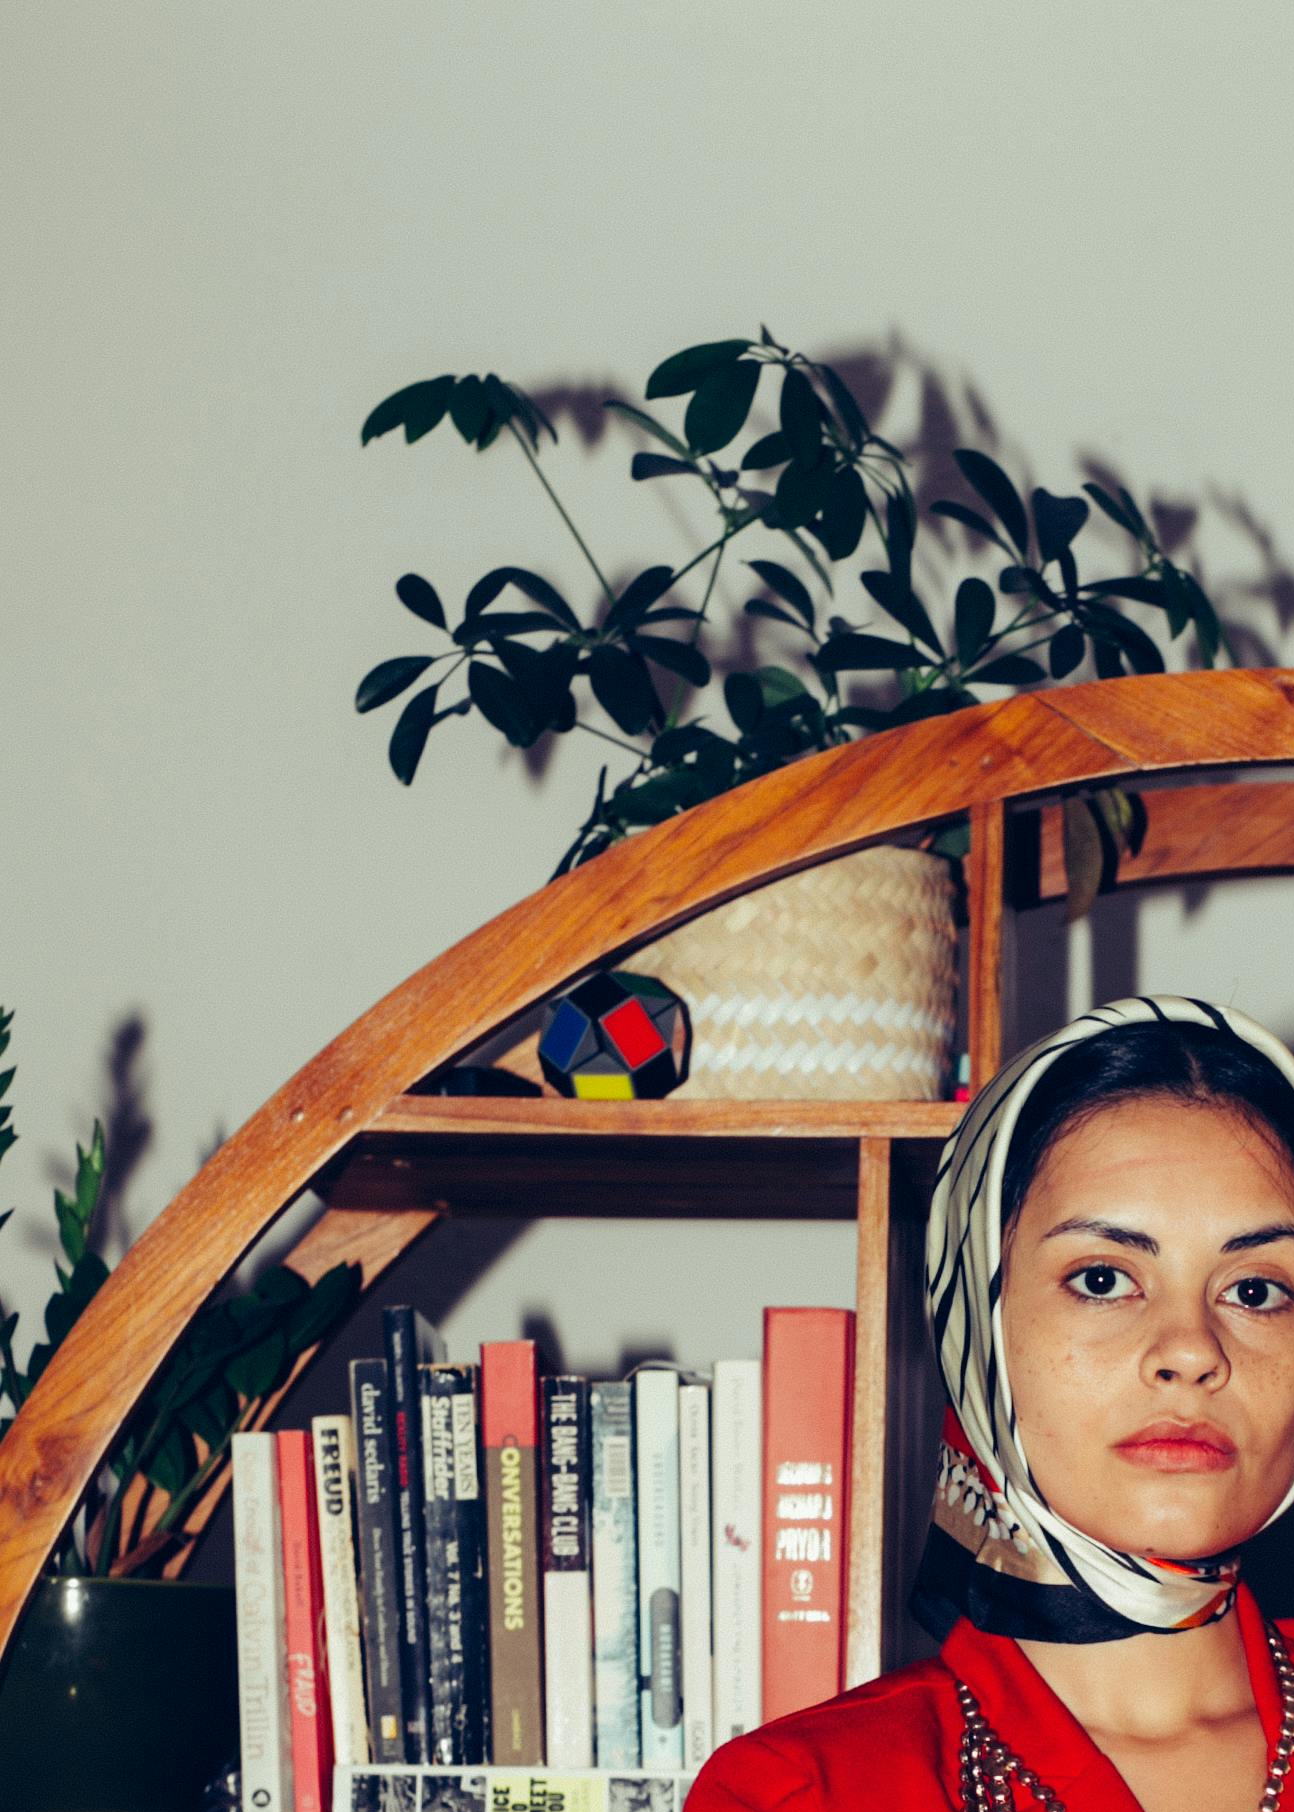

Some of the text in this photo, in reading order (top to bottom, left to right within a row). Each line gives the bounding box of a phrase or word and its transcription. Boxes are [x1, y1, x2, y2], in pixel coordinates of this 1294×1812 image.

[320, 1427, 344, 1516] FREUD
[360, 1383, 387, 1504] david sedaris
[430, 1395, 455, 1500] Staffrider
[456, 1399, 474, 1492] TEN YEARS
[550, 1393, 579, 1556] THE BANG-BANG CLUB
[499, 1435, 524, 1632] CONVERSATIONS
[241, 1581, 266, 1670] Calvin
[449, 1610, 461, 1621] 3
[449, 1624, 463, 1651] and
[450, 1653, 463, 1664] 4
[242, 1683, 270, 1761] Trillin
[287, 1651, 317, 1717] FRAUD
